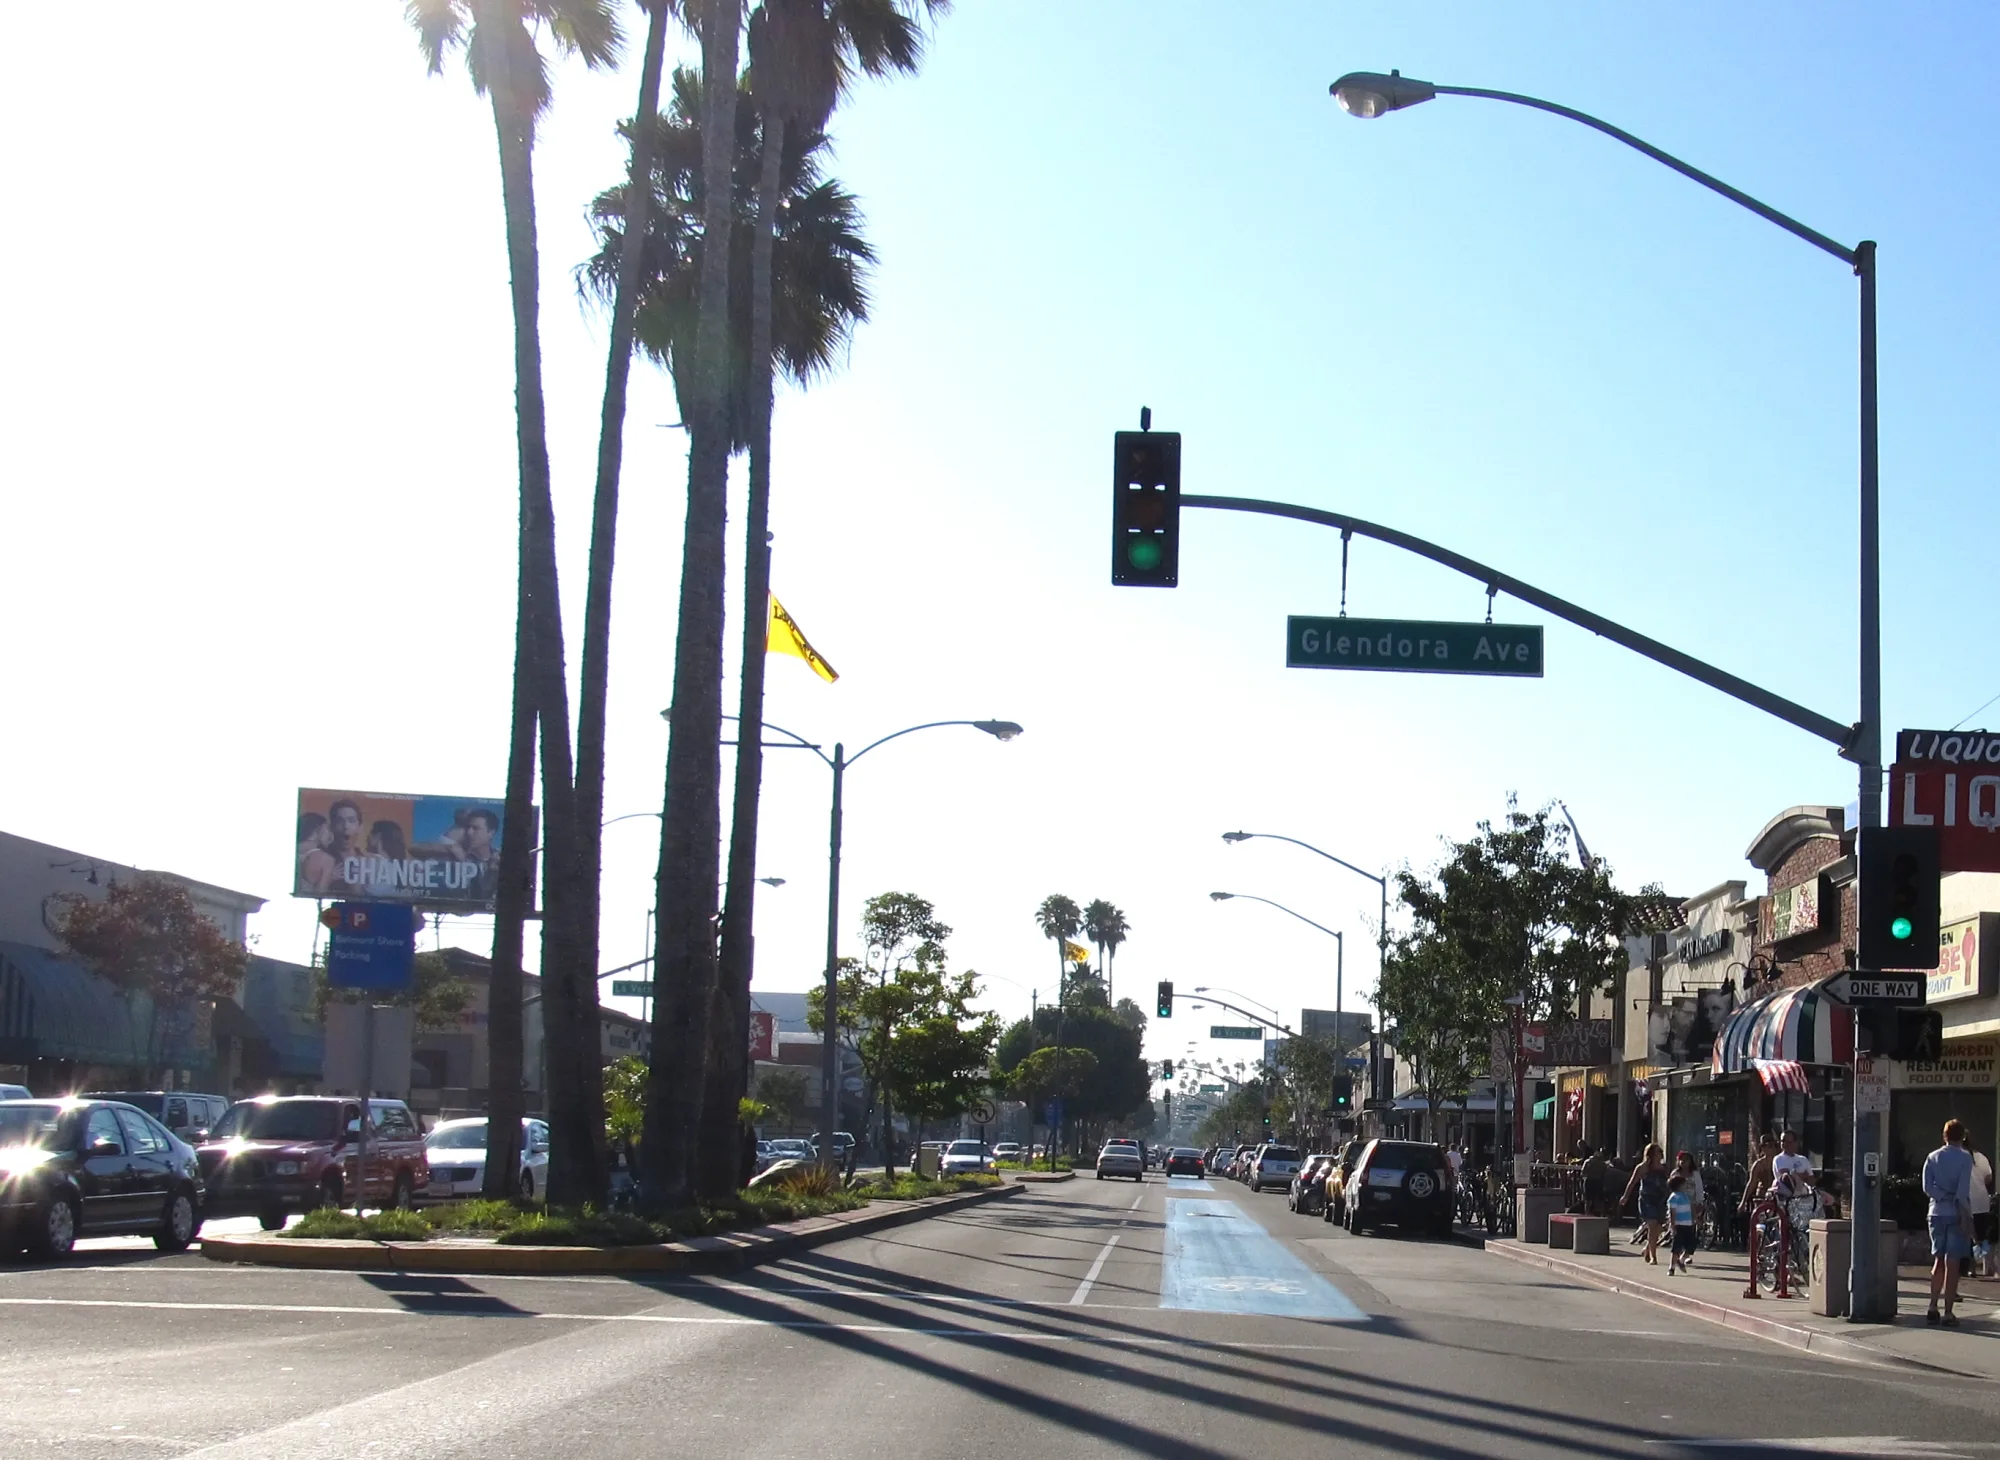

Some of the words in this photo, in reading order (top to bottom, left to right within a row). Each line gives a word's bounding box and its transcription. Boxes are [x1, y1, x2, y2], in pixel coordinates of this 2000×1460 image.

[1302, 628, 1448, 659] Glendora
[1472, 636, 1530, 662] Ave
[1909, 733, 2000, 764] LIQUO
[1903, 772, 2000, 833] LIQ
[344, 856, 477, 889] CHANGE-UP
[353, 912, 367, 927] P
[335, 949, 370, 962] Parking
[1850, 981, 1880, 995] ONE
[1885, 983, 1915, 997] WAY
[1906, 1059, 1995, 1072] RESTAURANT
[1908, 1074, 1943, 1084] FOOD
